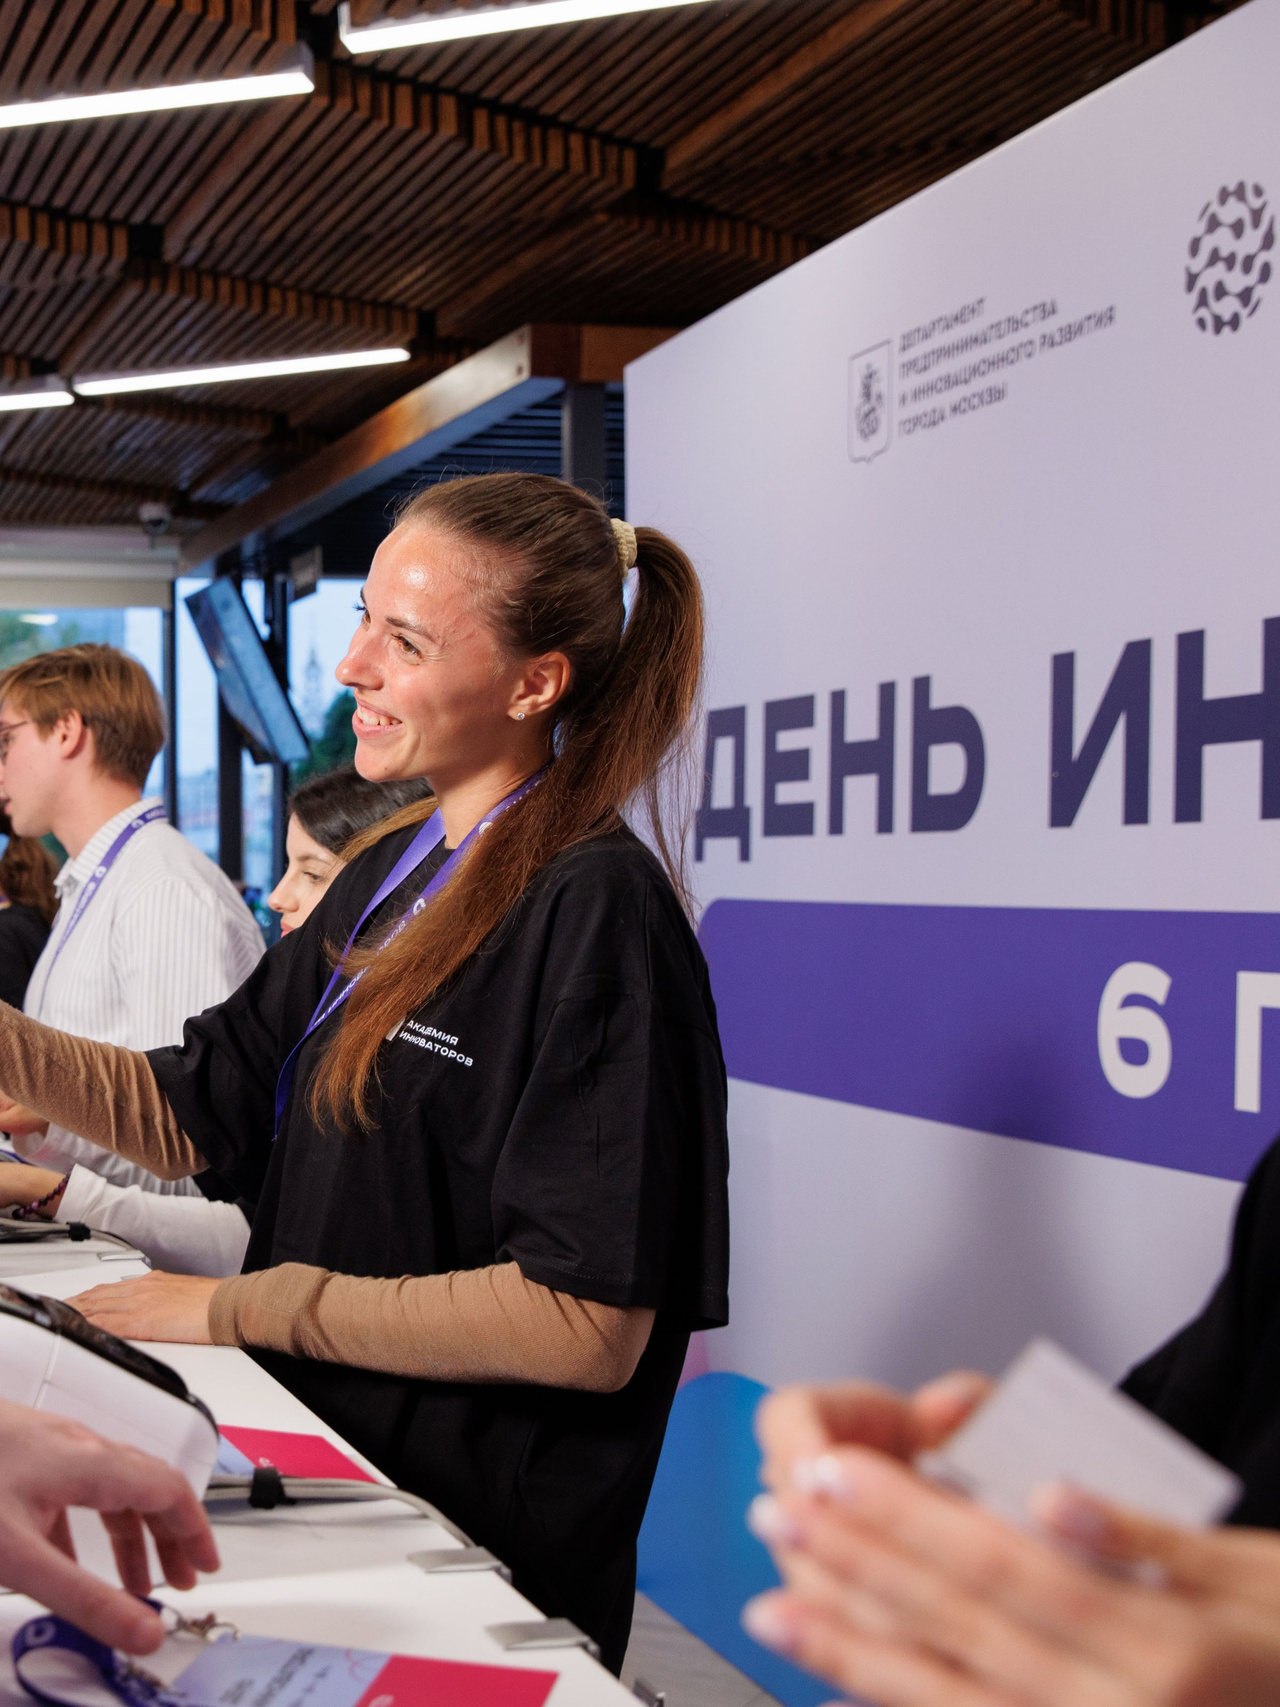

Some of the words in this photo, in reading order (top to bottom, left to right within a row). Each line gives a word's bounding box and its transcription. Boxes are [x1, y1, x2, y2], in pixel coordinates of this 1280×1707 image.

[898, 297, 986, 354] ДЕПАРТАМЕНТ
[899, 299, 1059, 379] ПРЕДПРИНИМАТЕЛЬСТВА
[911, 338, 1036, 402] ИННОВАЦИОННОГО
[1039, 303, 1116, 353] РАЗВИТИЯ
[898, 405, 947, 437] ГОРОДА
[948, 380, 1009, 417] МОСКВЫ
[693, 674, 986, 864] ДЕНЬ
[399, 1030, 474, 1067] ИННОВАТОРОВ
[406, 1019, 459, 1046] АКАДЕМИЯ
[1096, 960, 1172, 1099] 6
